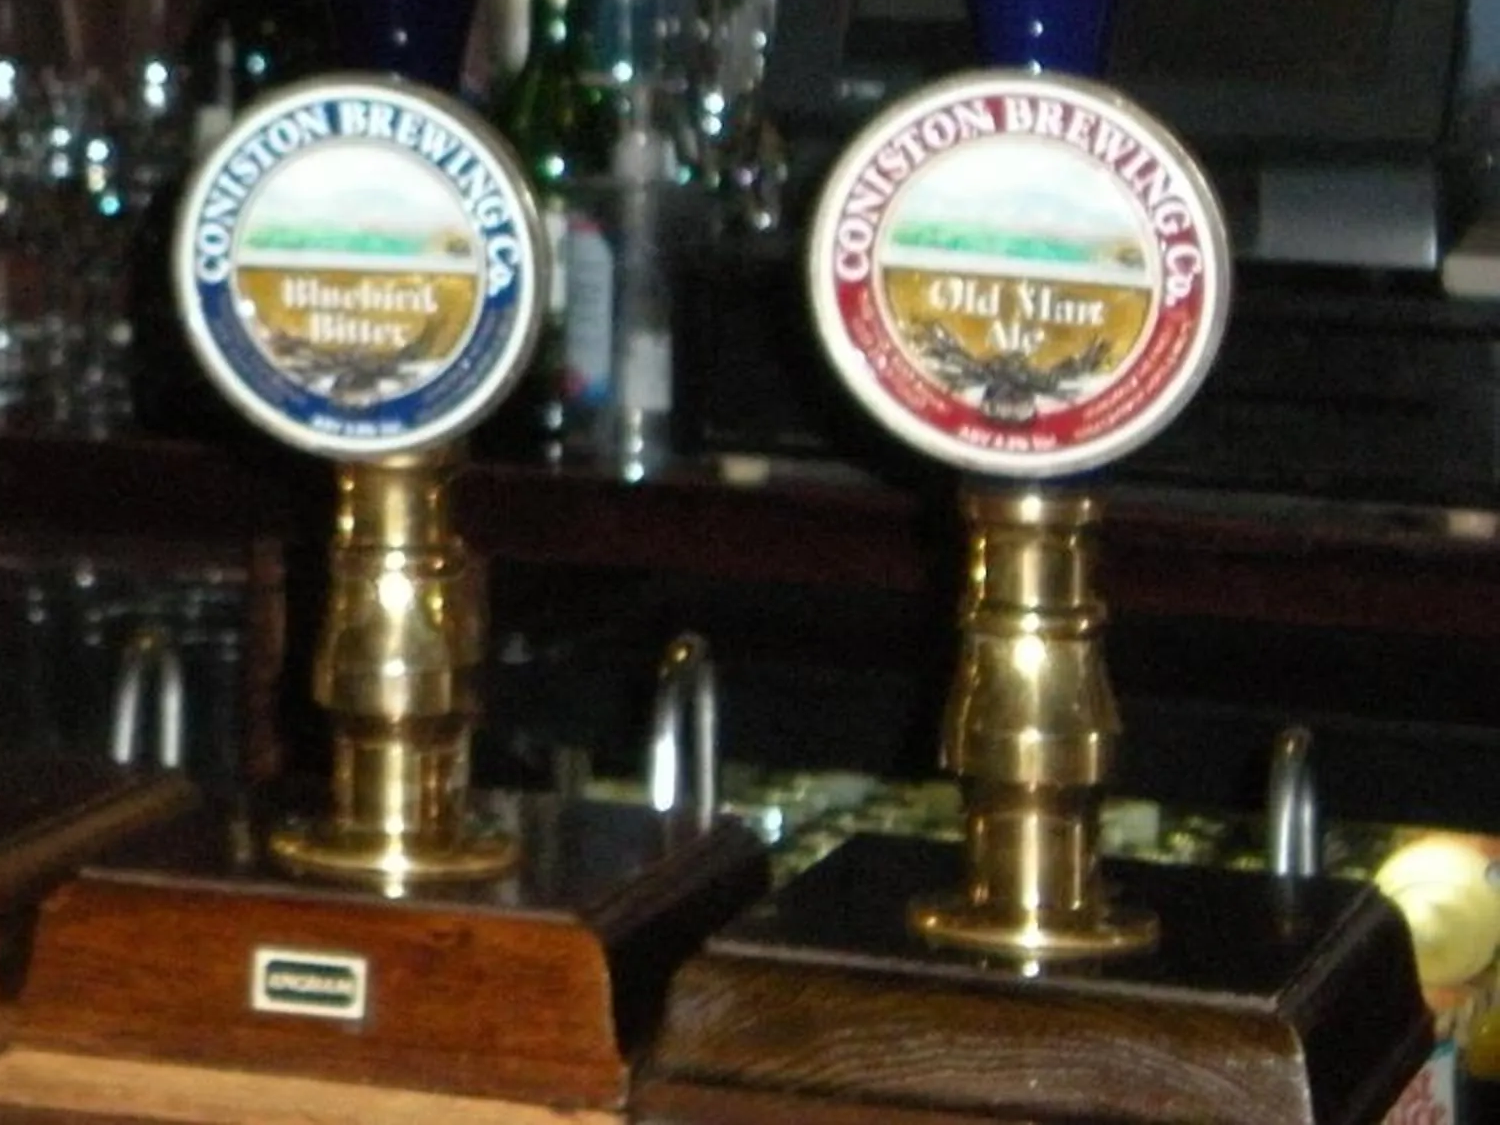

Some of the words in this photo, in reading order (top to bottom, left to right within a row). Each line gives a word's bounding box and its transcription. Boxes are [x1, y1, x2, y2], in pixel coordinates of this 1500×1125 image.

[199, 102, 331, 284] CONISTON
[337, 100, 507, 223] BREWING
[835, 99, 999, 282] CONISTON
[1003, 94, 1192, 235] BREWING
[928, 278, 1001, 316] Old
[1016, 281, 1106, 326] Man
[986, 320, 1046, 355] Ale
